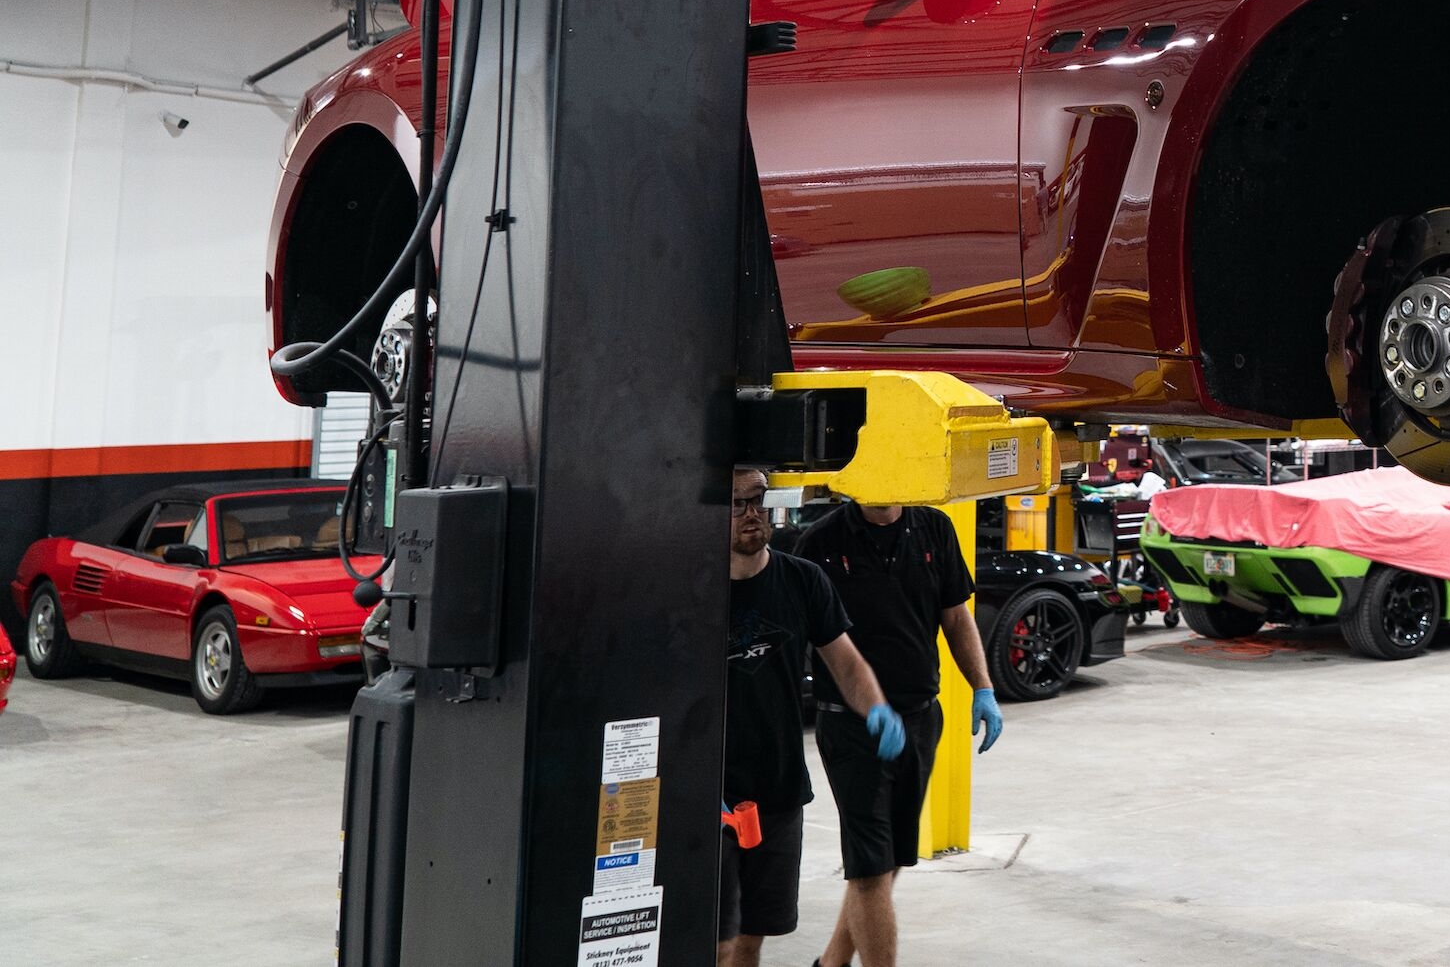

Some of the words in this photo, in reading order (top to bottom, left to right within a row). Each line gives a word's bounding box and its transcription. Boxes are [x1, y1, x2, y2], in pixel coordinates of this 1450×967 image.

[604, 856, 632, 866] NOTICE
[592, 914, 634, 928] AUTOMOTIVE
[635, 911, 650, 921] LIFT
[583, 927, 612, 939] SERVICE
[617, 920, 656, 933] INSPECTION
[586, 949, 613, 960] Stickney
[615, 943, 651, 954] Equipment
